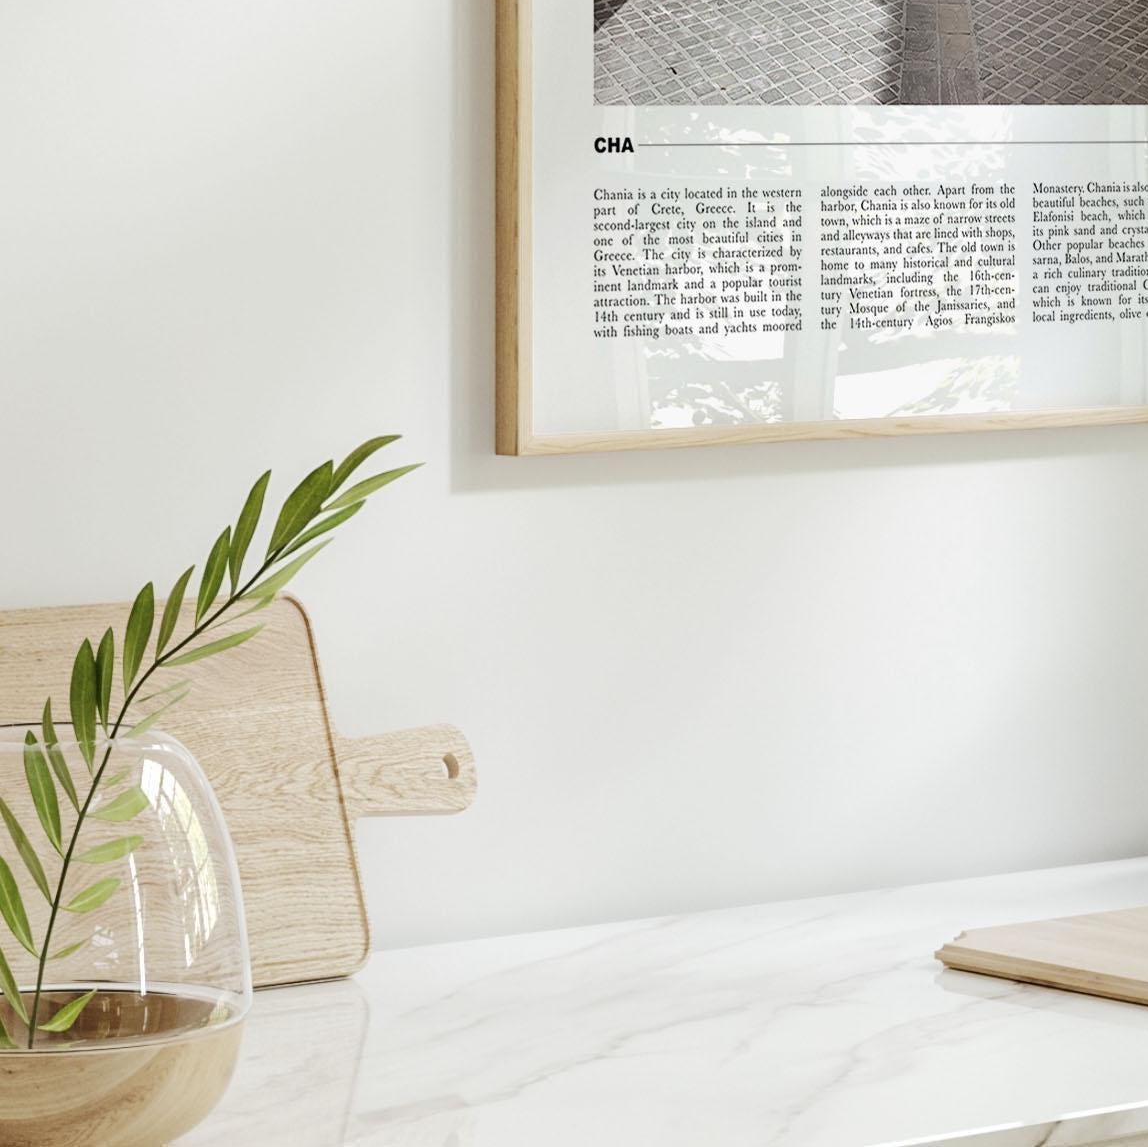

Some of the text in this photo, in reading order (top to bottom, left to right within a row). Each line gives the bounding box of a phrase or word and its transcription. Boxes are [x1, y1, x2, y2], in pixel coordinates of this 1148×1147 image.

[594, 136, 635, 154] CHA
[594, 189, 634, 200] Chania
[638, 188, 646, 200] is
[660, 188, 680, 203] city
[684, 187, 724, 199] located
[726, 187, 738, 198] in
[742, 187, 758, 198] the
[762, 189, 802, 198] western
[820, 183, 1016, 200] alongside each other. Apart from the
[1086, 182, 1122, 193] Chania
[1122, 181, 1130, 192] is
[820, 197, 1016, 213] harbor, Chania is also known for its old
[1032, 196, 1074, 208] beautiful
[1078, 194, 1120, 208] beaches,
[1124, 196, 1144, 206] such
[594, 201, 802, 219] part of Crete, Greece. It is the
[1032, 210, 1074, 222] Elafonisi
[1080, 210, 1112, 223] beach,
[1118, 209, 1146, 220] which
[594, 216, 802, 234] second-largest city on the island and
[1032, 226, 1044, 236] its
[1048, 225, 1070, 240] pink
[1074, 224, 1096, 236] sand
[1100, 224, 1118, 235] and
[820, 226, 1016, 244] and alleyways that are lined with shops,
[820, 242, 880, 257] restaurants,
[882, 243, 902, 254] and
[936, 241, 958, 253] The
[960, 241, 976, 253] old
[980, 240, 1004, 252] town
[1008, 240, 1016, 251] is
[1032, 238, 1062, 251] Other
[1066, 239, 1104, 253] popular
[1108, 236, 1146, 249] beaches
[594, 245, 802, 263] Greece. The city is characterized by
[594, 261, 802, 276] its Venetian harbor, which is a prom-
[820, 254, 1016, 272] home to many historical and cultural
[820, 273, 876, 286] landmarks,
[886, 270, 934, 287] including
[944, 270, 958, 282] the
[1044, 266, 1062, 279] rich
[1068, 267, 1106, 282] culinary
[594, 275, 802, 292] inent landmark and a popular tourist
[1056, 282, 1082, 296] enjoy
[1088, 279, 1136, 292] traditional
[594, 290, 802, 307] attraction. The harbor was built in the
[820, 292, 842, 303] tury
[848, 287, 894, 299] Venetian
[900, 285, 940, 299] fortress,
[946, 285, 962, 296] the
[820, 318, 836, 329] the
[924, 313, 954, 329] Agios
[964, 312, 1016, 327] Frangiskos
[1032, 310, 1056, 322] local
[1060, 309, 1116, 324] ingredients,
[1120, 308, 1142, 319] olive
[594, 319, 802, 340] with fishing boats and yachts moored
